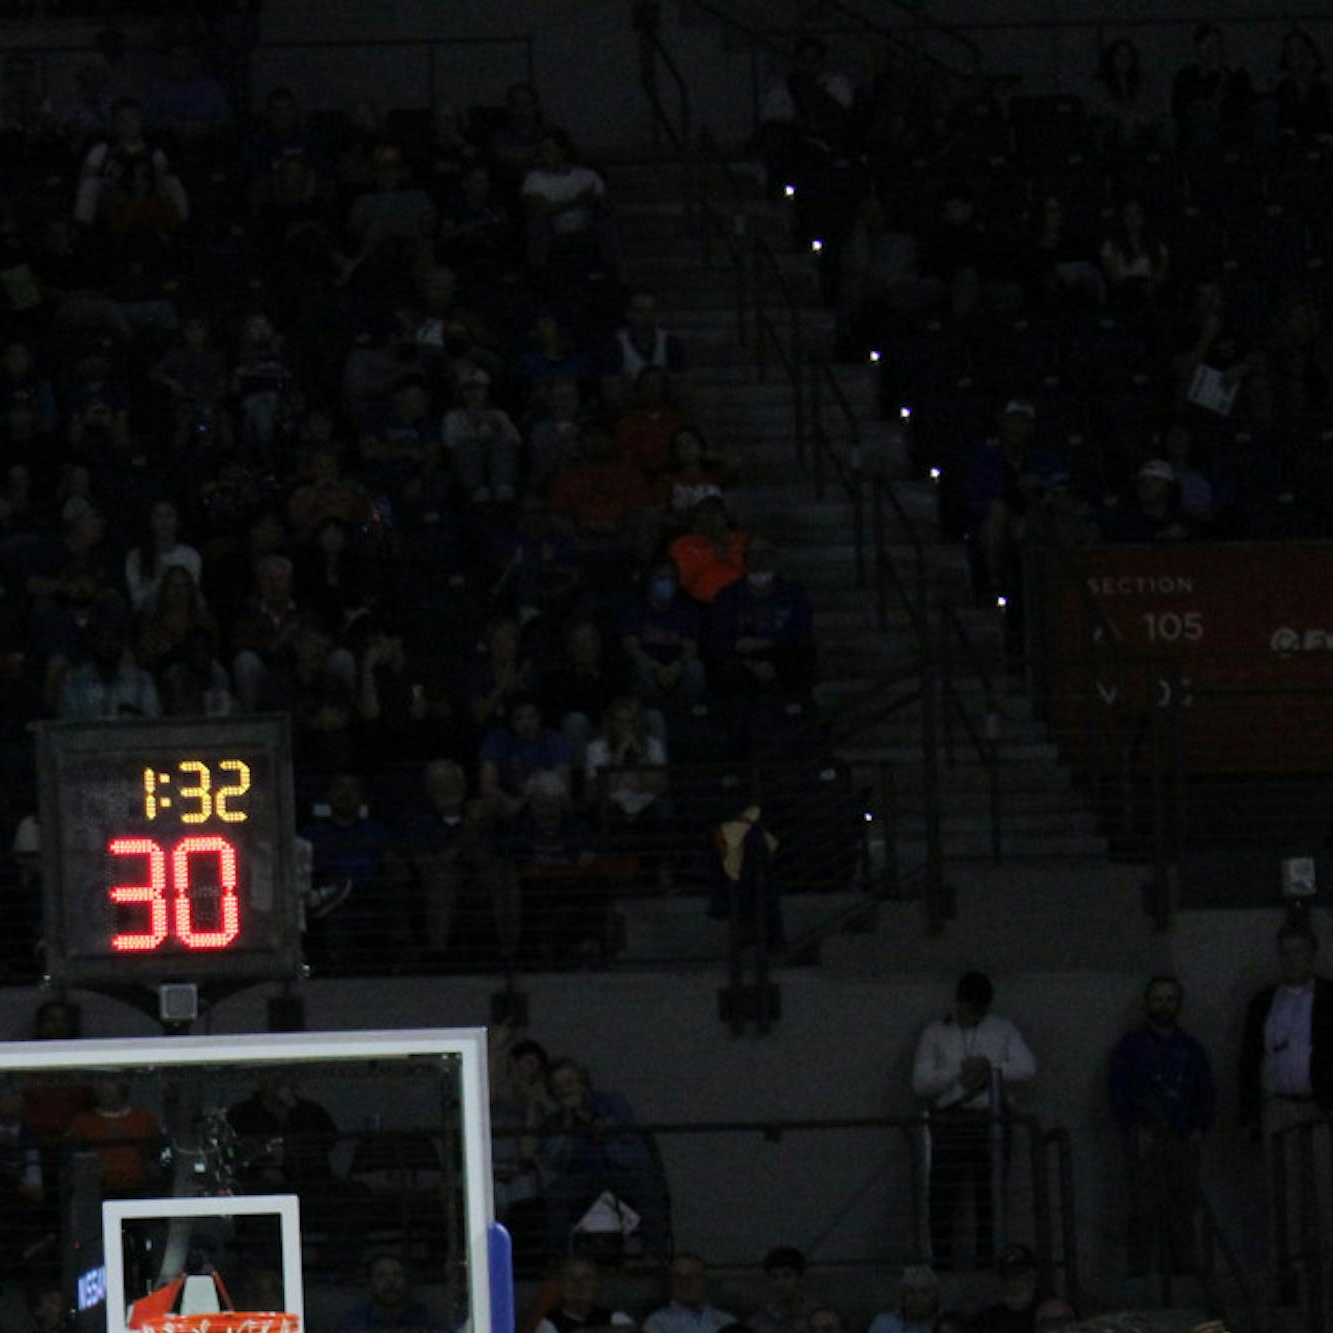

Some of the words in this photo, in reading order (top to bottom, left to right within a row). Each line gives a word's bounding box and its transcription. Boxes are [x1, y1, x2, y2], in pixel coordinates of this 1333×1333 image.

[1086, 577, 1194, 594] SECTION
[1140, 612, 1204, 641] 105
[143, 760, 251, 824] 1:32
[109, 836, 239, 950] 30
